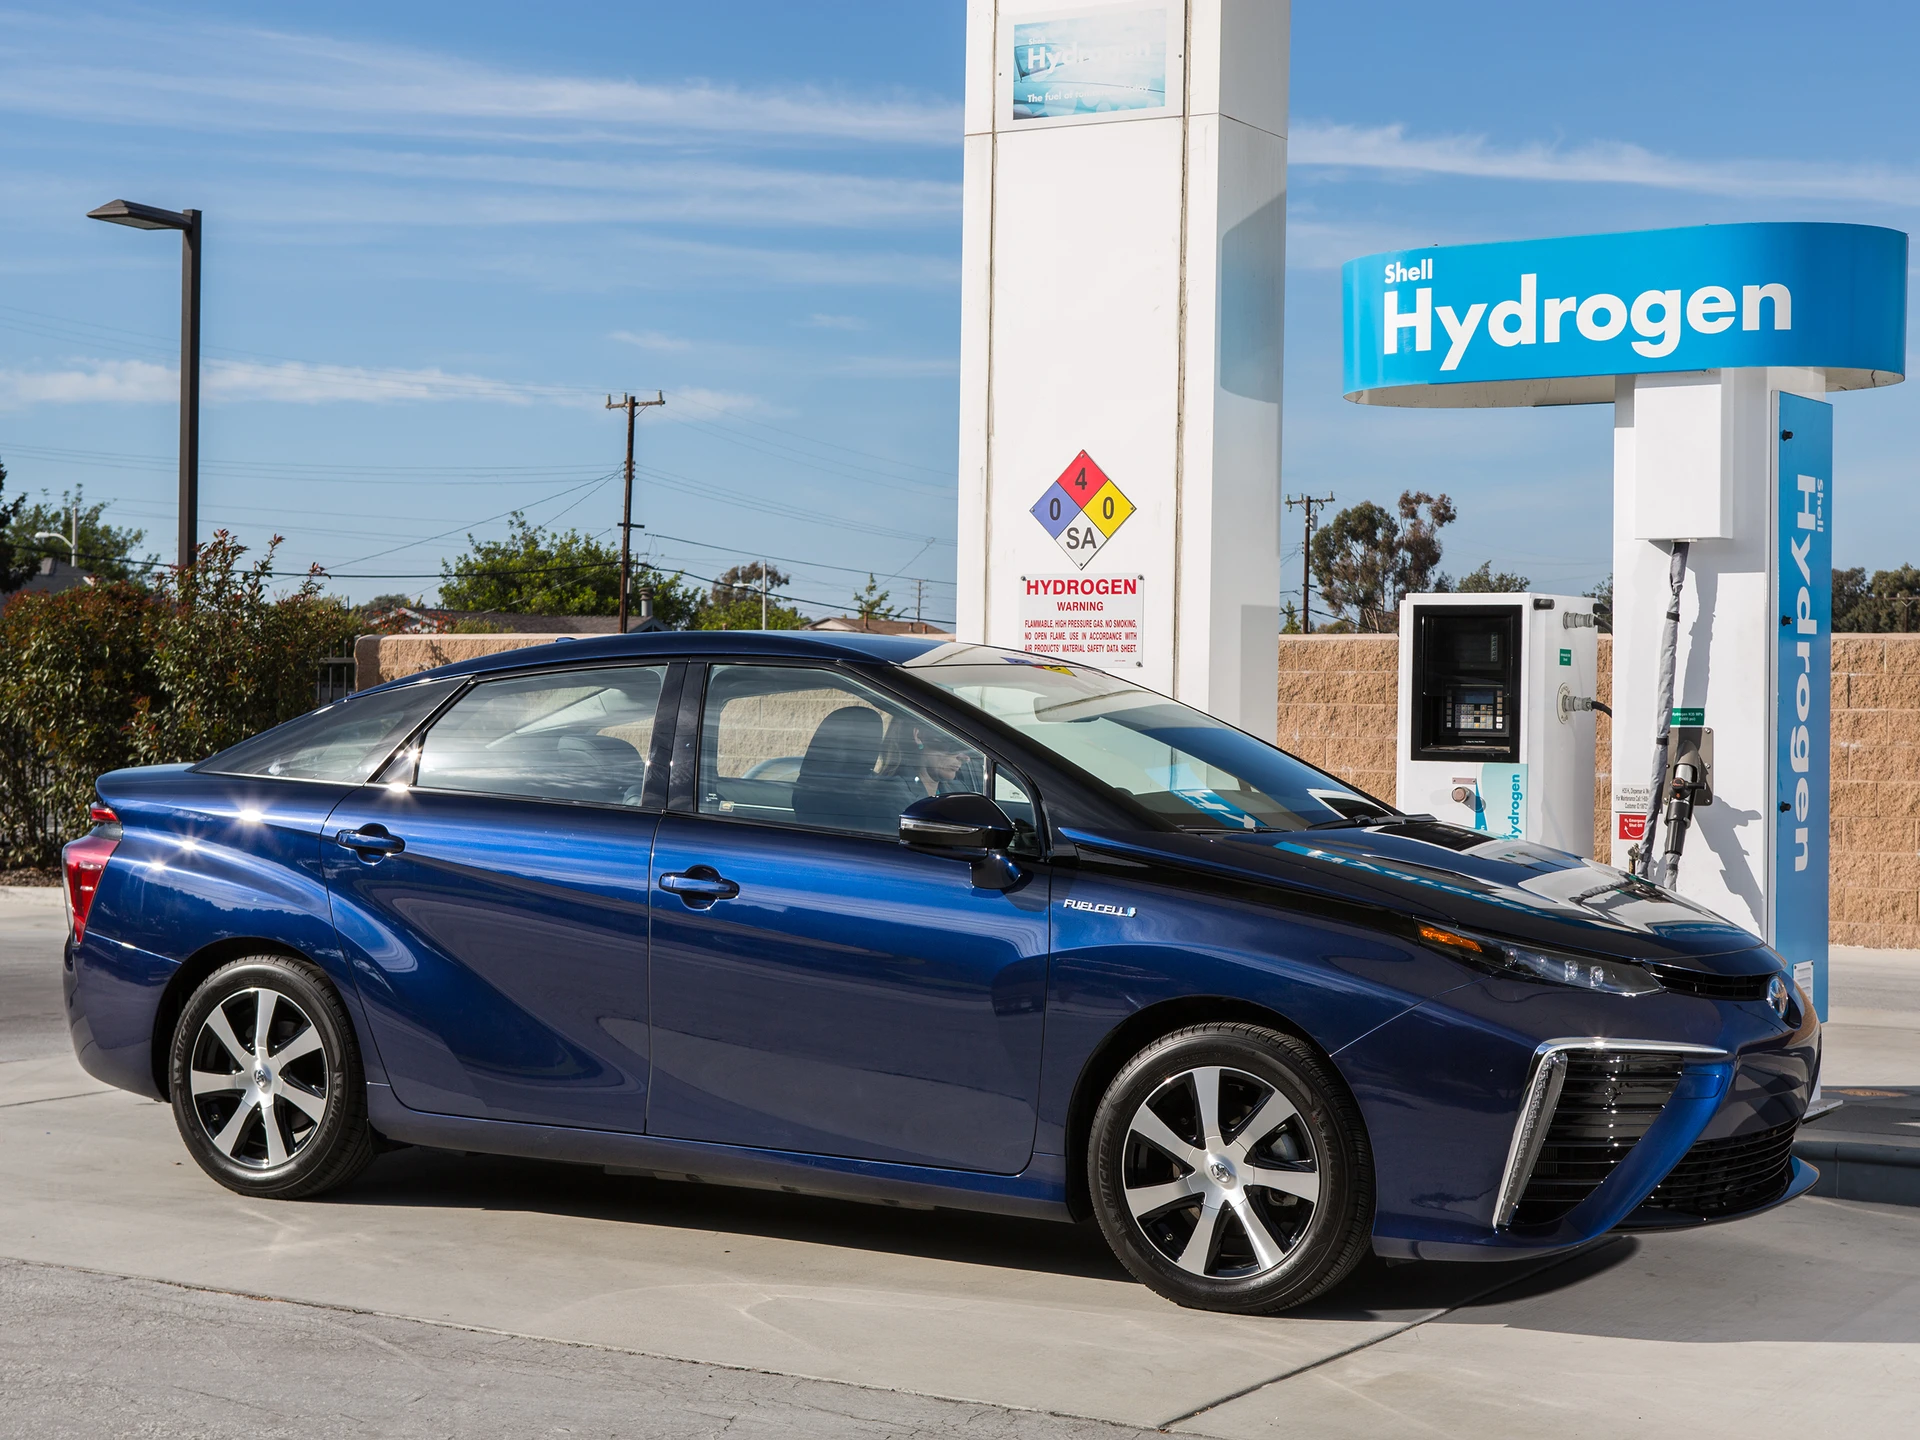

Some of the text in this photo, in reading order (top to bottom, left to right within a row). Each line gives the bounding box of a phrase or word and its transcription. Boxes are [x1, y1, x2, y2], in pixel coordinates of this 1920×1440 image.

[1027, 94, 1043, 103] The
[1045, 91, 1062, 101] fuel
[1064, 90, 1074, 99] of
[1384, 258, 1433, 284] Shell
[1383, 273, 1792, 371] Hydrogen
[1075, 467, 1088, 490] 4
[1049, 496, 1115, 521] 0 0
[1066, 526, 1097, 549] SA
[1026, 578, 1137, 595] HYDROGEN
[1056, 601, 1104, 612] WARNING
[1024, 619, 1138, 629] FLAMMABLE, HIGH PRESSURE GAS. NO SMOKING,
[1024, 631, 1138, 641] NO OPEN FLAME. USE IN ACCORDANCE WITH
[1024, 644, 1033, 653] AIR
[1062, 644, 1085, 653] MATERIAL
[1087, 644, 1105, 653] SAFETY
[1106, 644, 1119, 653] DATA
[1120, 644, 1138, 653] SHEET.
[1790, 474, 1818, 873] Hydrogen
